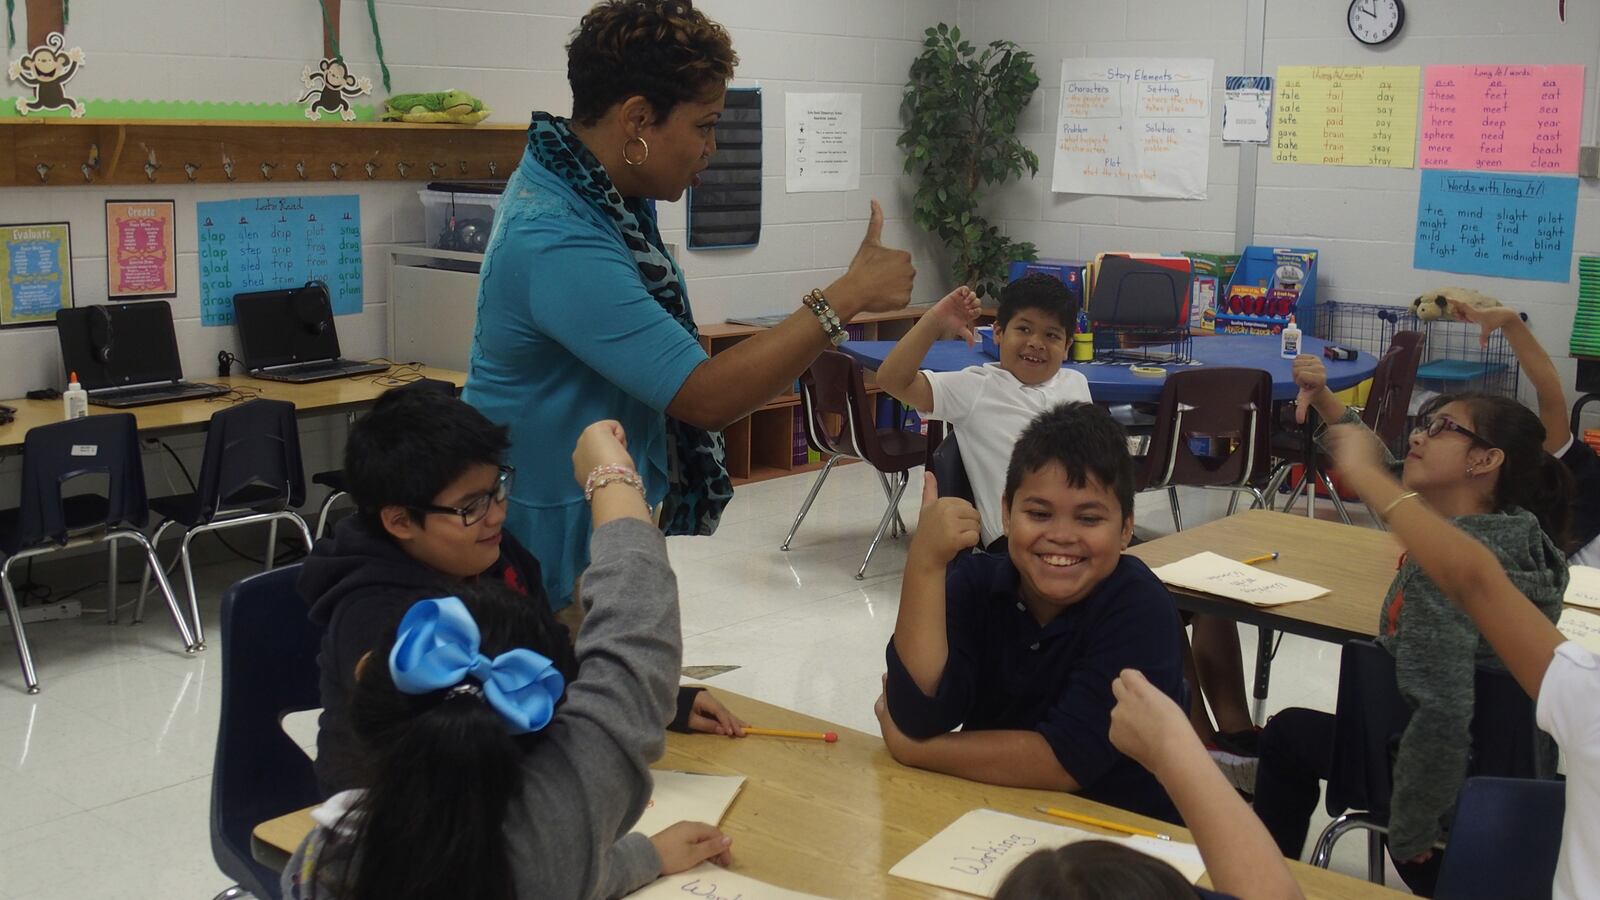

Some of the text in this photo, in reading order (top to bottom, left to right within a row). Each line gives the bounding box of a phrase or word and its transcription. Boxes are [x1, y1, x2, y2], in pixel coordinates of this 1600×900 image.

[1107, 68, 1173, 84] Story Elements
[1068, 83, 1109, 94] Characters
[1147, 84, 1180, 96] Setting
[1280, 88, 1300, 99] tale
[1326, 89, 1343, 100] tail
[1377, 89, 1395, 102] day
[1484, 88, 1508, 99] feet
[1541, 88, 1562, 100] eat
[1280, 101, 1393, 117] sale sail say
[1483, 101, 1508, 113] meet
[1539, 106, 1558, 114] sea
[1279, 113, 1391, 128] safe paid pay
[1432, 115, 1560, 130] here deep year
[1063, 124, 1088, 133] Problem
[1145, 123, 1175, 134] Solution
[1278, 127, 1392, 142] gave brain stay
[1424, 128, 1562, 141] sphere need east
[1323, 139, 1344, 151] train
[1480, 142, 1503, 153] feed
[1532, 142, 1562, 154] beach
[1105, 157, 1120, 167] Plot
[1276, 150, 1392, 165] date paint stray
[1476, 159, 1502, 168] green
[1530, 155, 1560, 168] clean
[1448, 179, 1475, 193] Words
[1479, 179, 1498, 192] with
[1503, 182, 1522, 198] long
[127, 207, 156, 217] Create
[1425, 204, 1564, 225] tie mind slight pilot
[13, 228, 52, 240] Evaluate
[201, 229, 225, 245] slap
[239, 226, 259, 243] glen
[271, 225, 291, 240] drip
[1420, 218, 1565, 240] might pie find sight
[1420, 230, 1561, 251] mild tight lie blind
[202, 244, 228, 261] clap
[240, 246, 262, 258] step
[272, 246, 292, 259] grip
[1430, 244, 1544, 265] fight die midnight
[203, 261, 229, 275] glad
[240, 258, 260, 271] sled
[272, 259, 294, 271] trip
[338, 252, 362, 265] drum
[202, 277, 232, 294] grab
[242, 271, 265, 287] shed
[272, 272, 295, 285] trim
[203, 283, 361, 307] drag plum
[204, 310, 232, 322] trap
[949, 833, 1037, 876] Working
